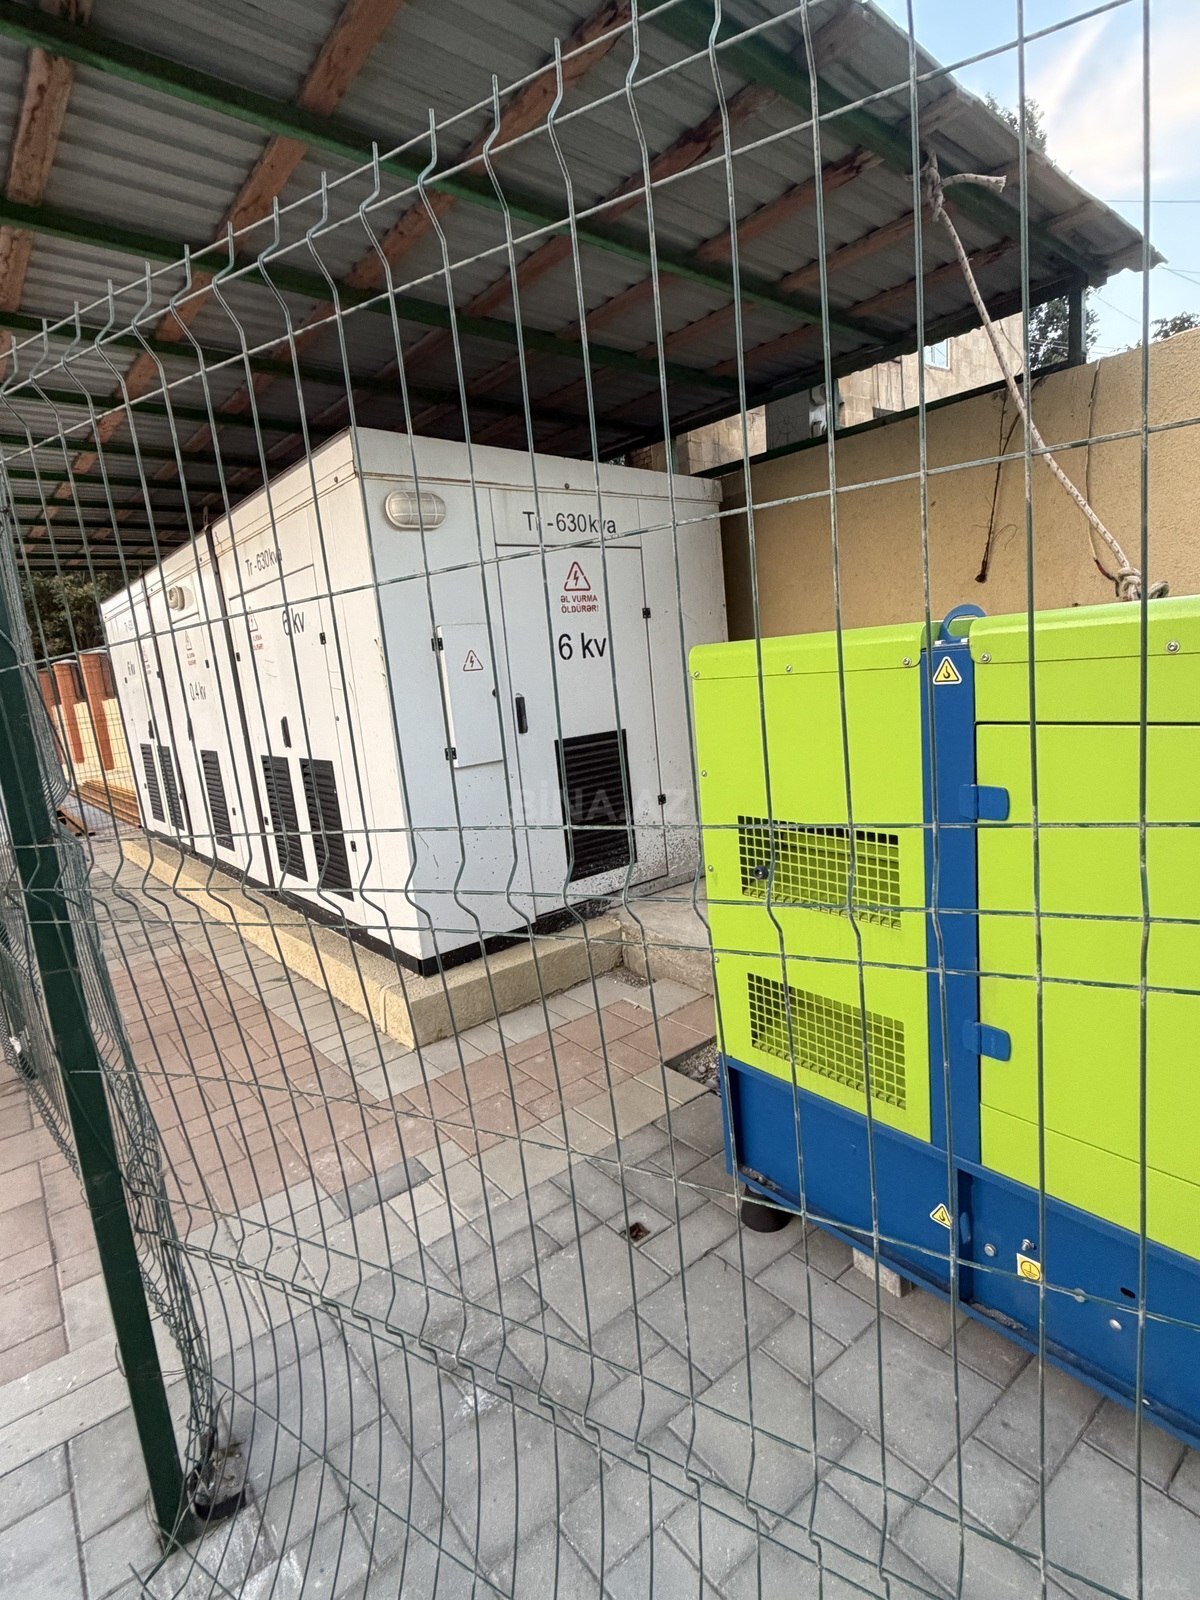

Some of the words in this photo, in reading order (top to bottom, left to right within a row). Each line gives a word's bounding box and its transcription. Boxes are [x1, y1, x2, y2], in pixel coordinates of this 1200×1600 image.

[571, 594, 598, 603] VURMA
[290, 607, 304, 634] kv
[558, 633, 573, 660] 6
[580, 632, 607, 659] kv
